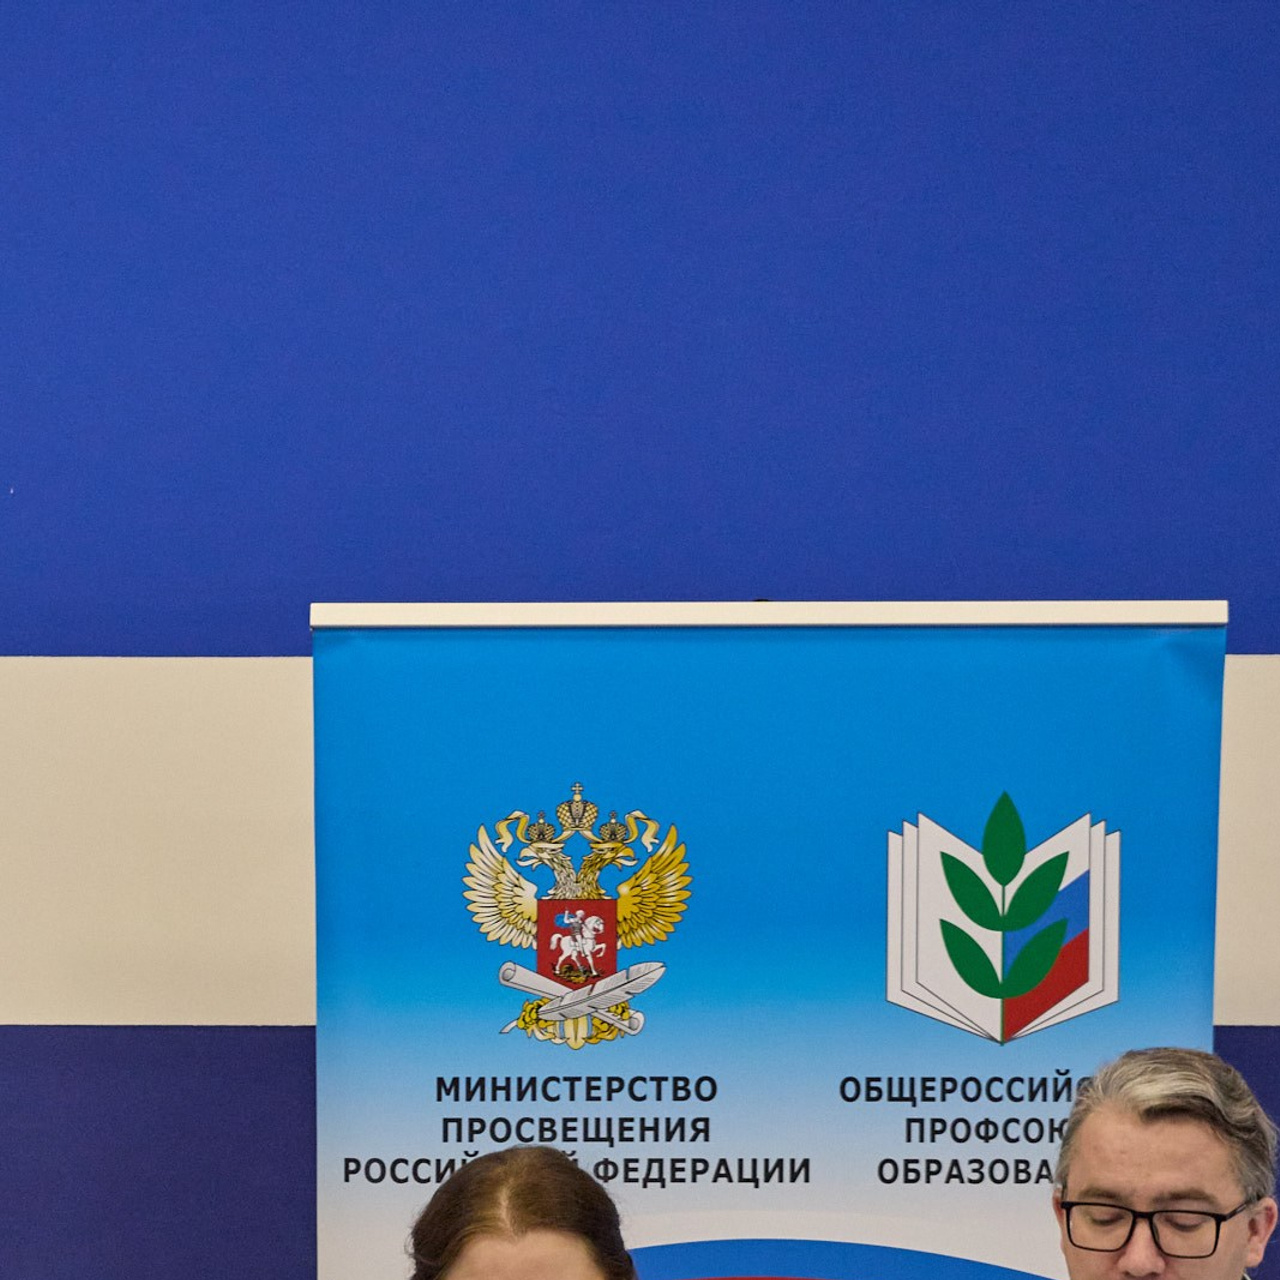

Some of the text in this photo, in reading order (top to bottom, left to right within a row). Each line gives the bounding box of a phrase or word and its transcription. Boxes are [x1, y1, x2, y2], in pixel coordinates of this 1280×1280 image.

[435, 1075, 718, 1103] МИНИСТЕРСТВО
[441, 1116, 711, 1148] ПРОСВЕЩЕНИЯ
[592, 1157, 811, 1189] ФЕДЕРАЦИИ
